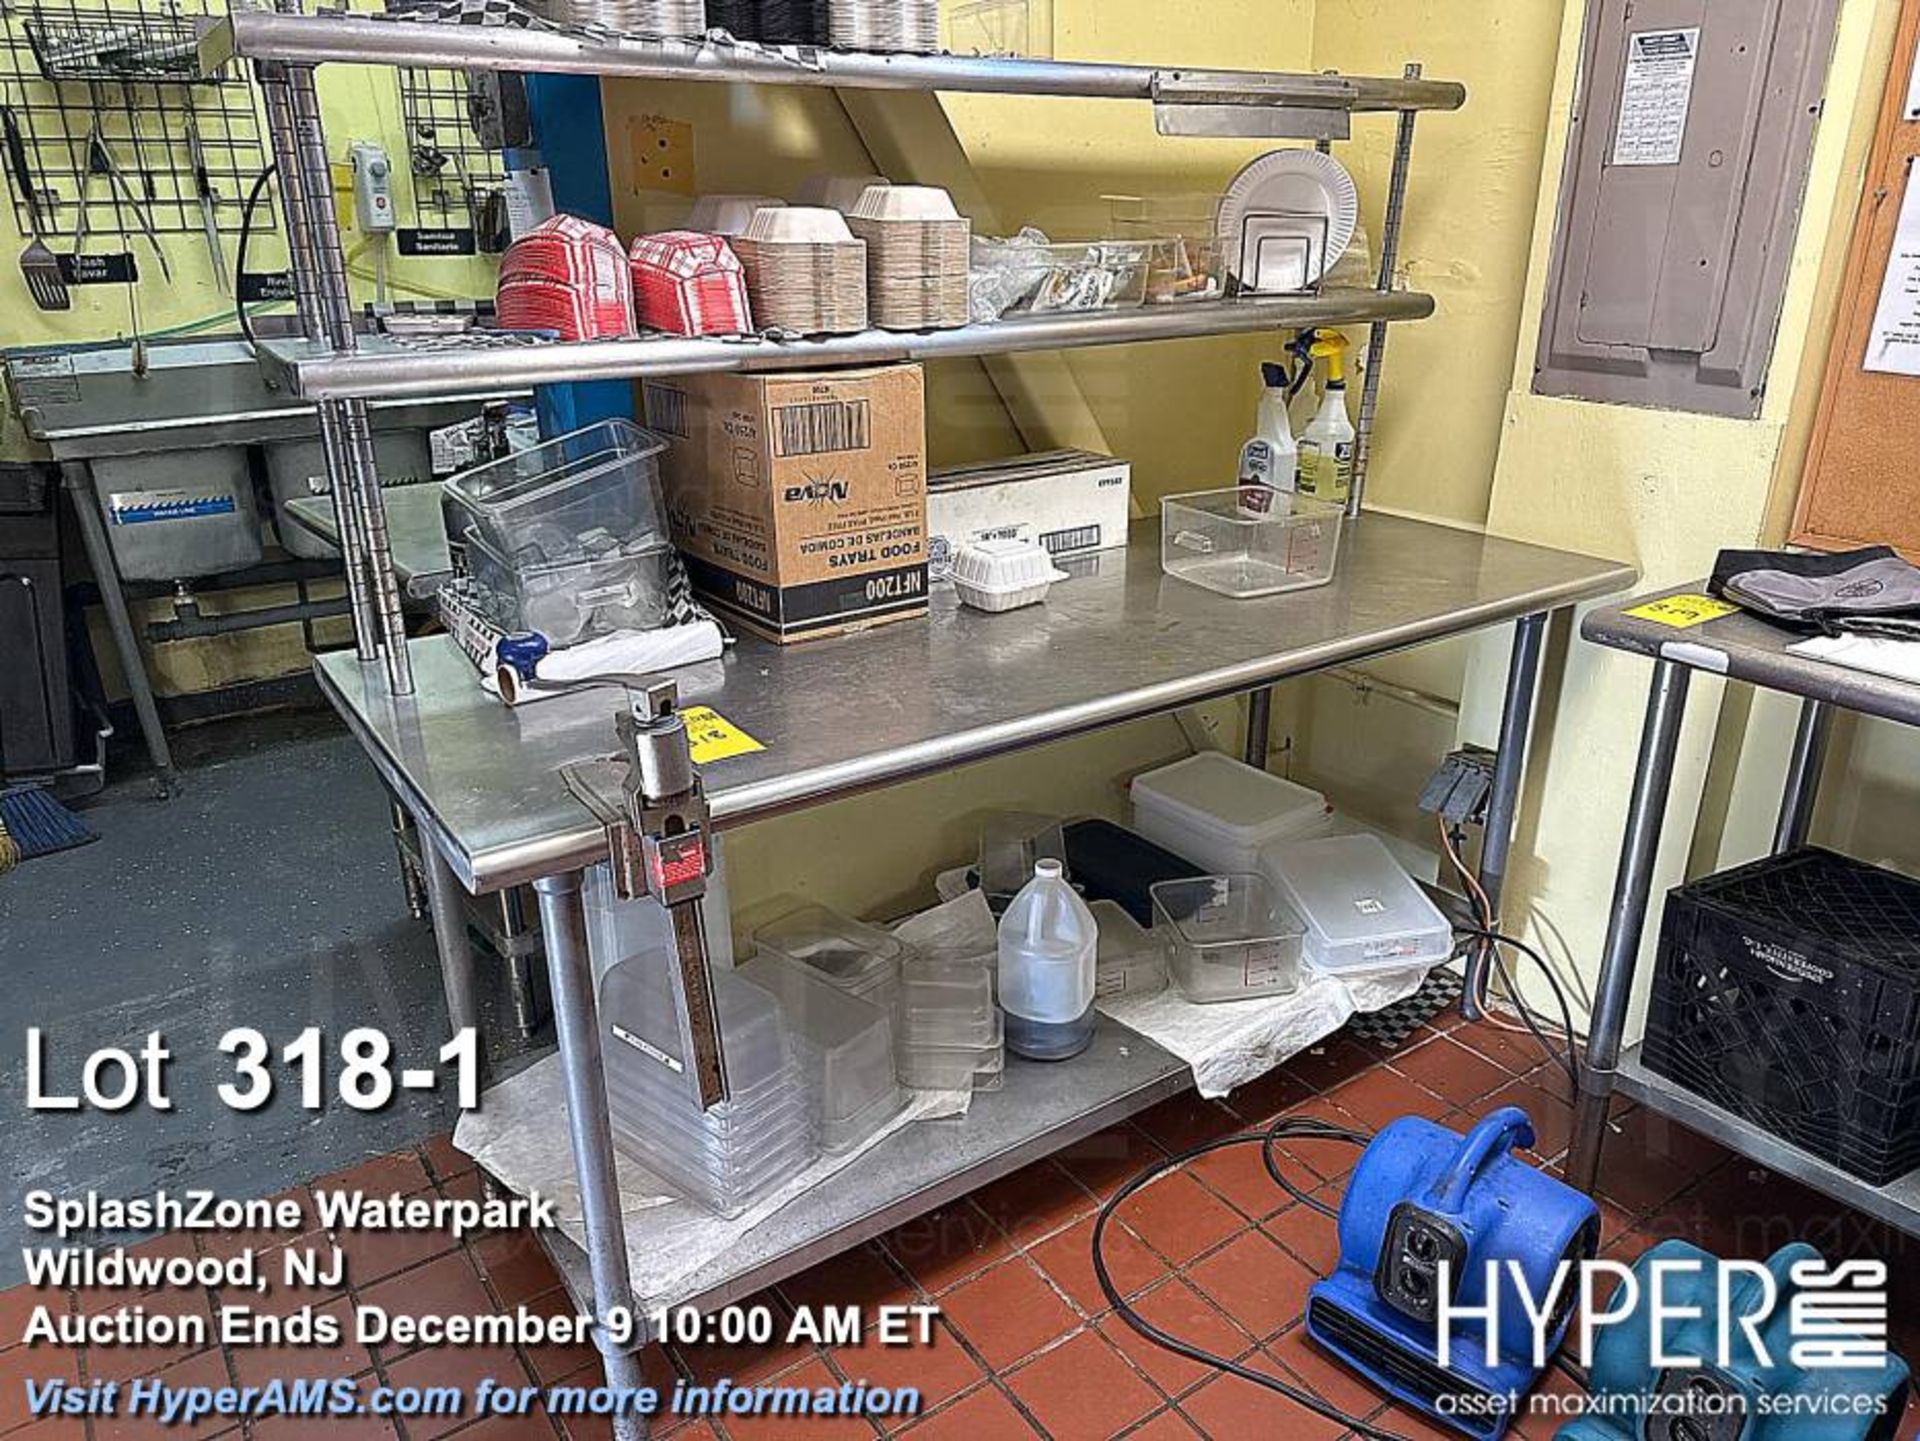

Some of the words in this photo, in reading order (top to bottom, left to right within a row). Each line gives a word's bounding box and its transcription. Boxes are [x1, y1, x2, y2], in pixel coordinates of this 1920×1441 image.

[784, 481, 849, 502] Nova
[848, 535, 863, 546] DE
[866, 526, 921, 545] BANDEJAS
[800, 538, 845, 555] COMIDA
[880, 541, 921, 558] FOOD
[829, 549, 877, 568] TRAYS
[865, 570, 921, 600] NFT200
